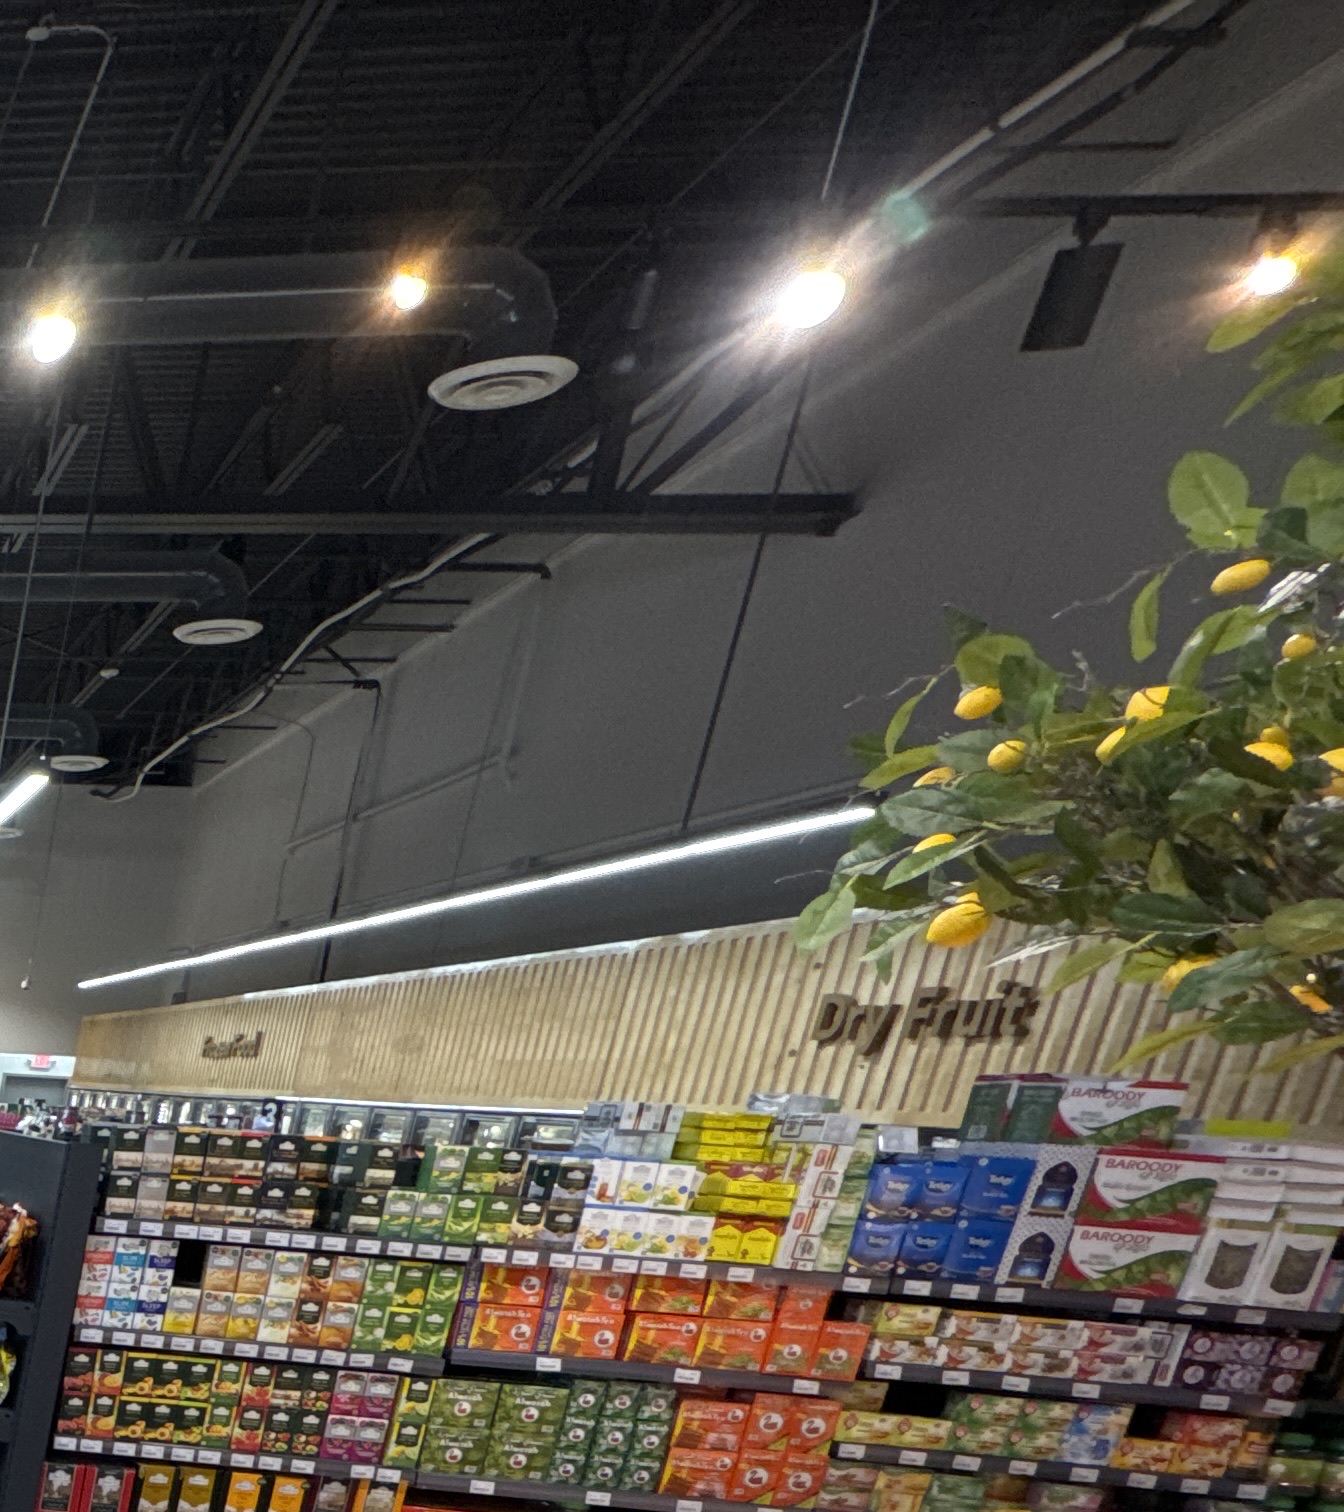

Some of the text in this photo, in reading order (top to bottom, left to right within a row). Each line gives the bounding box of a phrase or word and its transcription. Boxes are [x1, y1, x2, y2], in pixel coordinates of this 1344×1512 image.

[811, 992, 904, 1058] Dry
[1070, 1087, 1147, 1102] BAROODY
[1104, 1158, 1183, 1174] BAROODY
[1079, 1230, 1156, 1245] BAROODY
